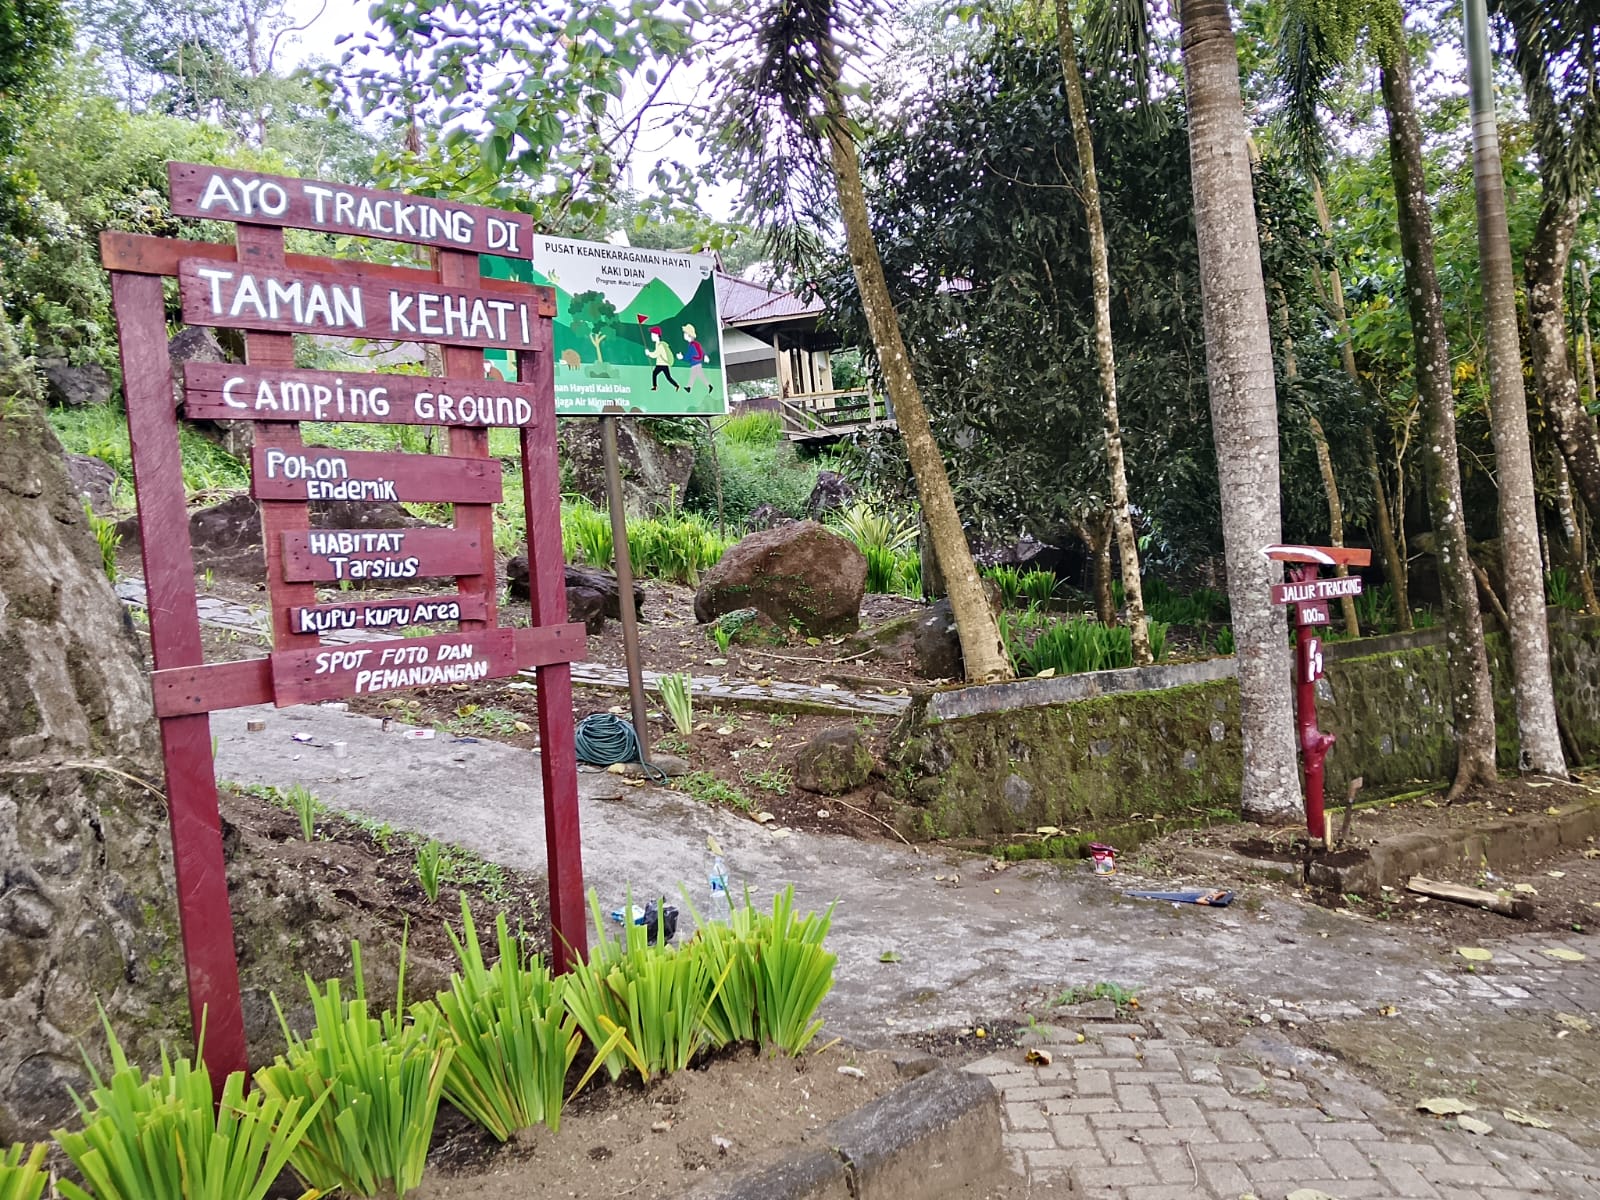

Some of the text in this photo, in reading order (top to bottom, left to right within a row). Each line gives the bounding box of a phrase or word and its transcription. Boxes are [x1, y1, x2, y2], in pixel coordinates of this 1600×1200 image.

[200, 174, 521, 253] AYO TRACKING DI
[545, 242, 575, 254] PUSAT
[577, 246, 660, 265] KEANEKARAGAMAN
[662, 256, 691, 268] HAYATI
[601, 265, 645, 279] KAKI DIAN
[198, 268, 530, 344] TAMAN KEHATI
[570, 384, 595, 395] Hayati
[596, 384, 613, 393] Kaki
[614, 384, 632, 394] Dian
[575, 397, 587, 406] Air
[266, 448, 348, 481] Pohon
[309, 532, 405, 555] HABITAT
[328, 555, 420, 578] Tarsius
[1280, 579, 1361, 602] JALUR TRACKING
[300, 601, 461, 632] KUPU-KUPU Area
[1302, 608, 1326, 623] 100m
[314, 643, 474, 675] SPOT FOTO DAN
[355, 661, 488, 694] PEMANDANGAN
